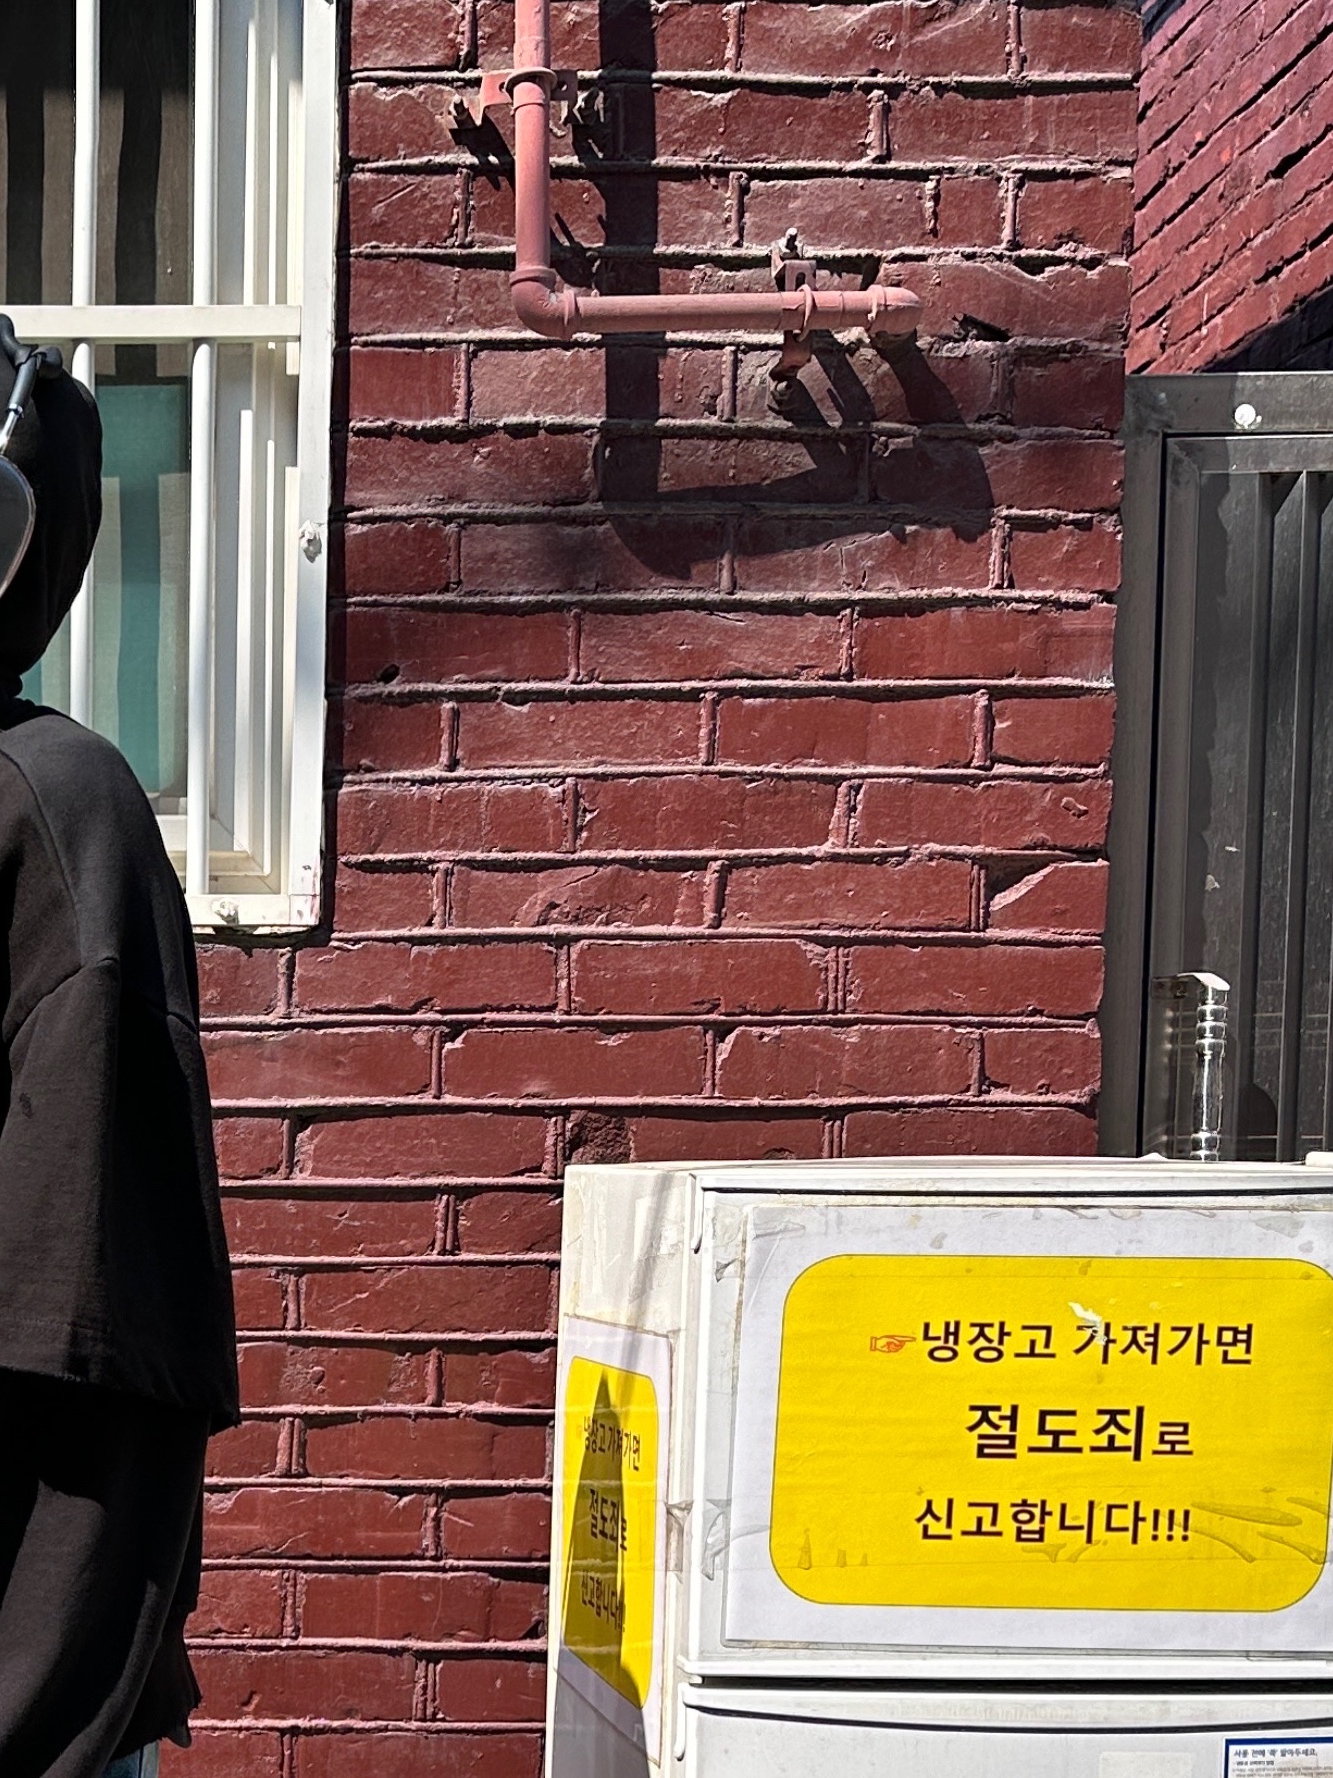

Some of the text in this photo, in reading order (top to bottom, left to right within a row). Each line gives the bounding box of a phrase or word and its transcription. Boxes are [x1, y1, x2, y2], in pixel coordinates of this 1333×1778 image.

[922, 1320, 1254, 1366] 냉장고 가져가면
[965, 1403, 1195, 1462] 절도죄로
[589, 1488, 627, 1553] 절도죄로
[915, 1497, 1191, 1545] 신고합니다!!!
